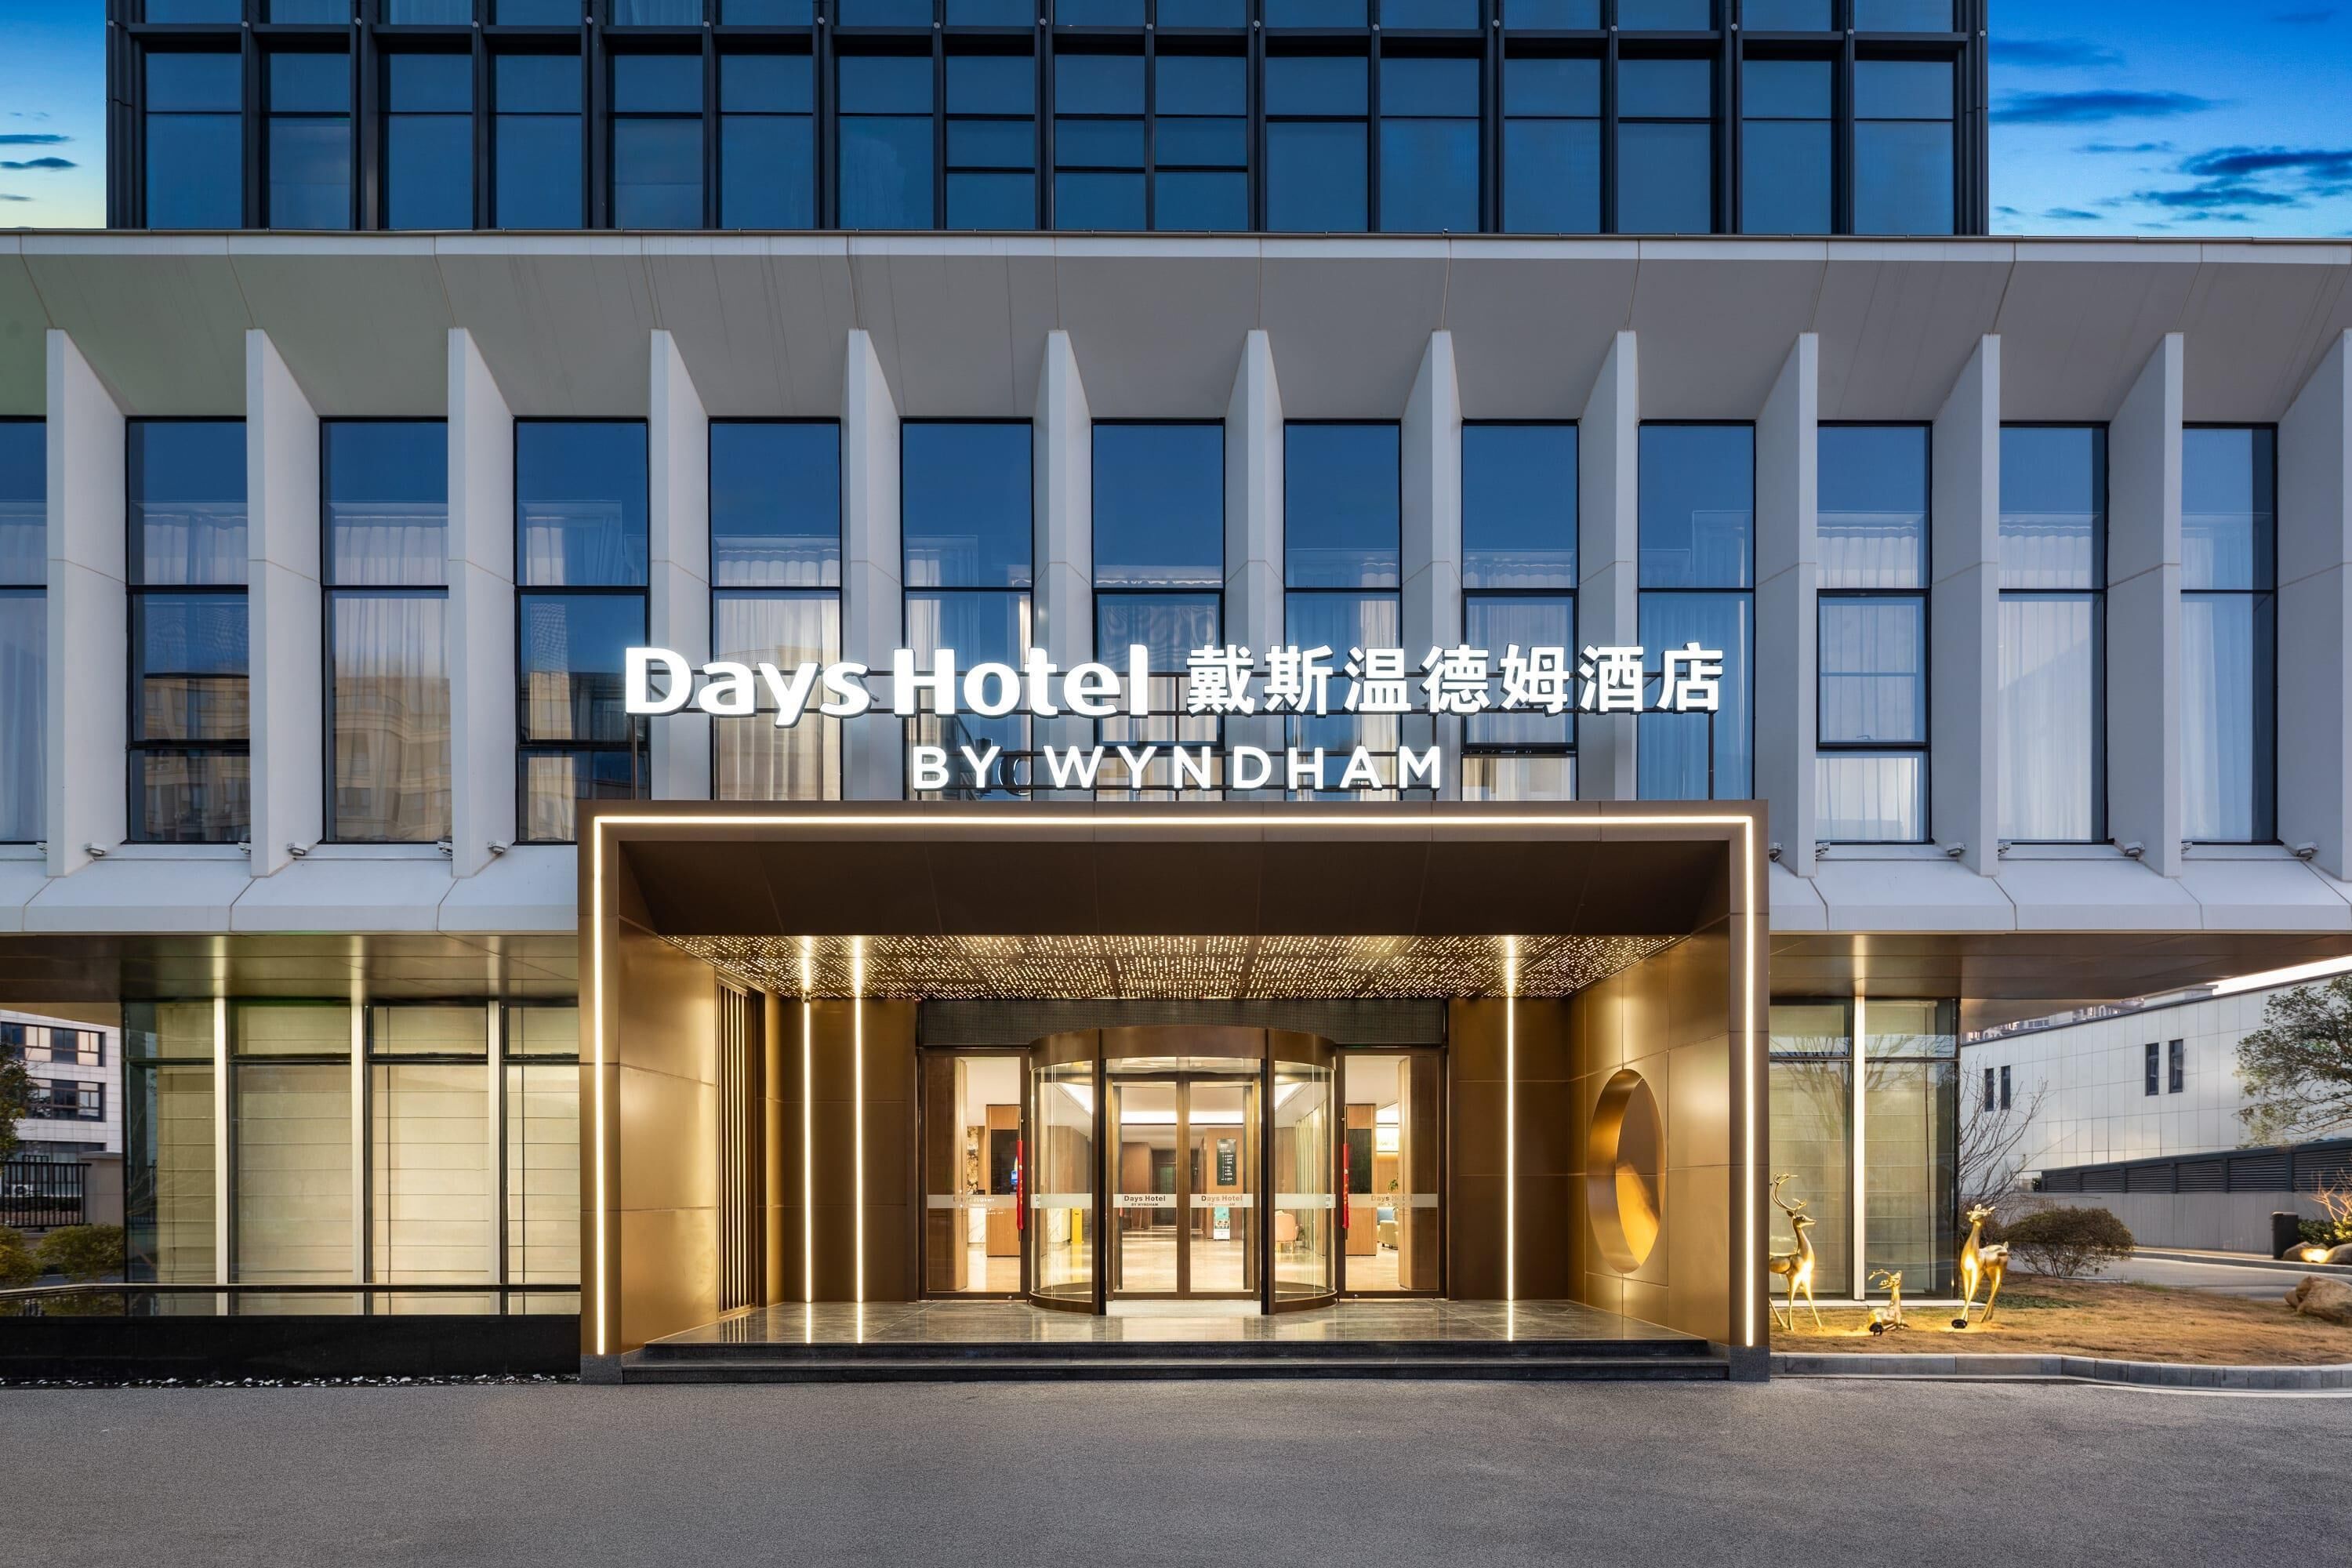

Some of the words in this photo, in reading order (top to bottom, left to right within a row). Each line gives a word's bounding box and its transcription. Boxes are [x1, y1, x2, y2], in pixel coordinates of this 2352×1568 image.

[625, 647, 871, 728] Days
[894, 643, 1149, 717] Hotel
[1186, 642, 1724, 715] 戴斯温德姆酒店
[913, 746, 1001, 789] BY
[1044, 746, 1441, 789] WYNDHAM
